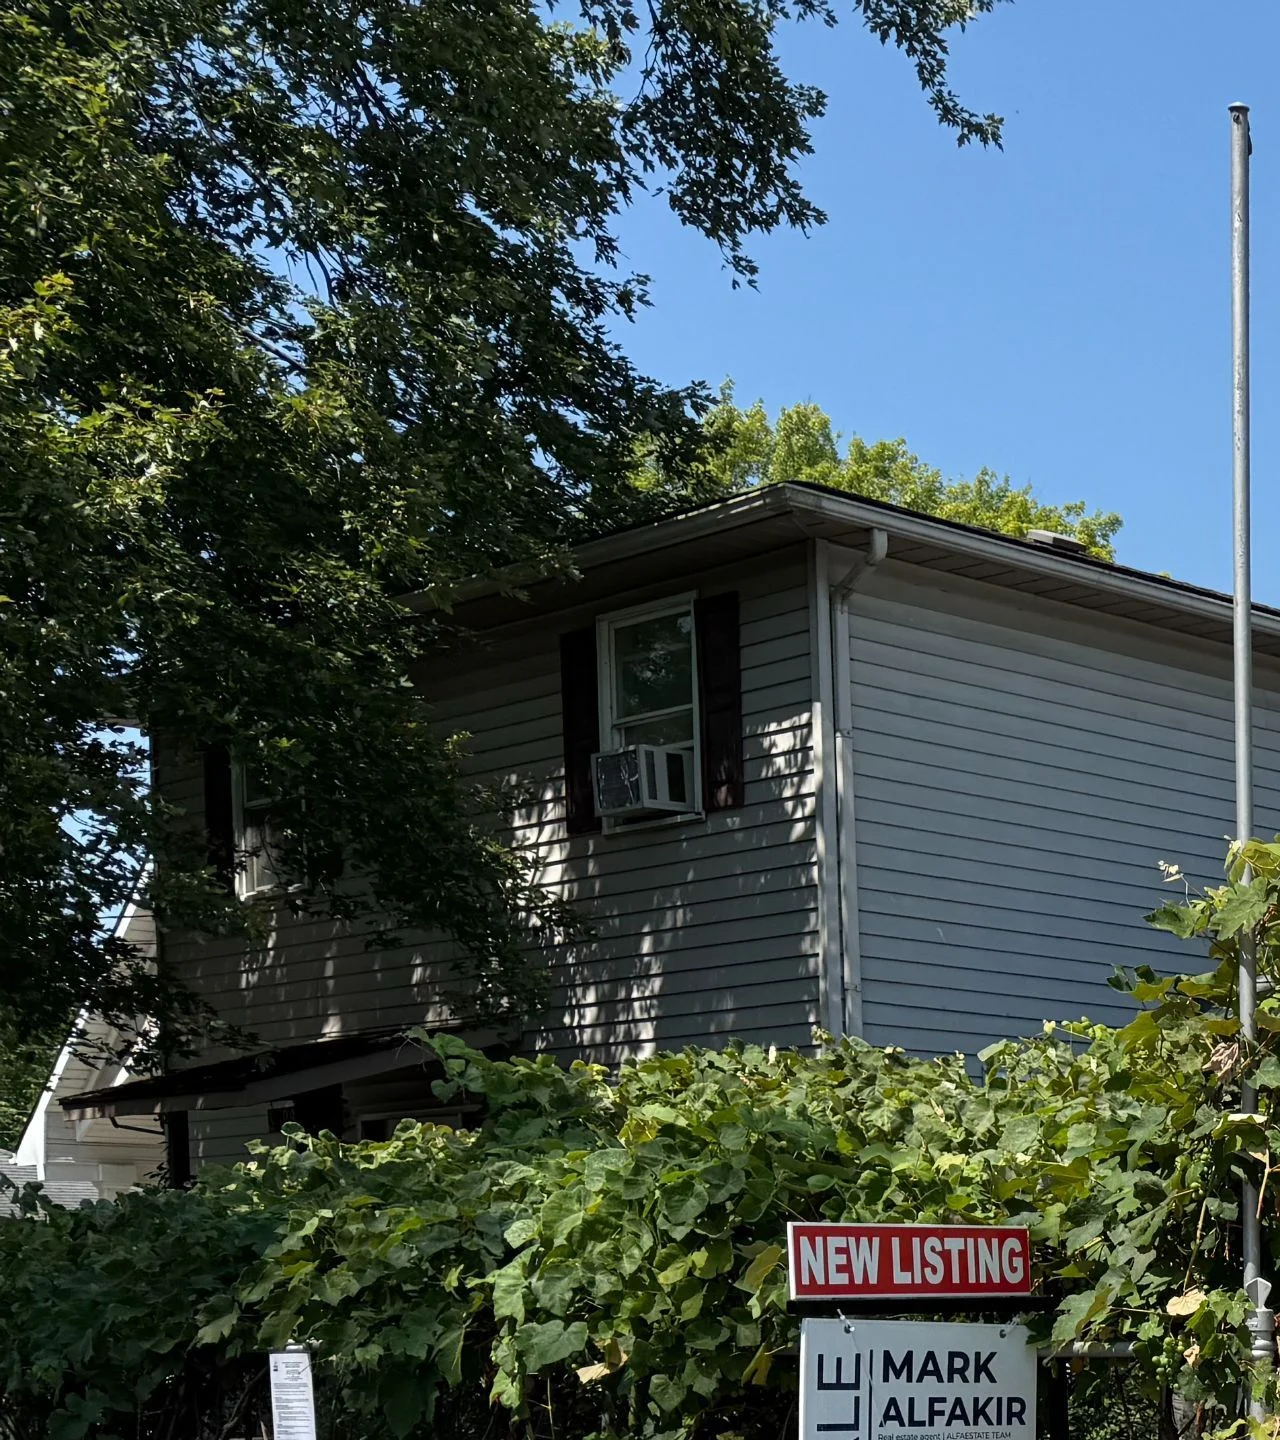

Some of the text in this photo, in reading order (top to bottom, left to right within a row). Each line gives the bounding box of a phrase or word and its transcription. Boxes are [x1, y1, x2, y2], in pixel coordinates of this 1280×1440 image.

[799, 1236, 1024, 1285] NEW LISTING
[882, 1350, 997, 1384] MARK
[878, 1396, 1027, 1428] ALFAKIR
[877, 1433, 894, 1440] Real
[895, 1433, 918, 1440] estate
[946, 1431, 990, 1440] ALFAESTATE
[991, 1431, 1012, 1439] TEAM
